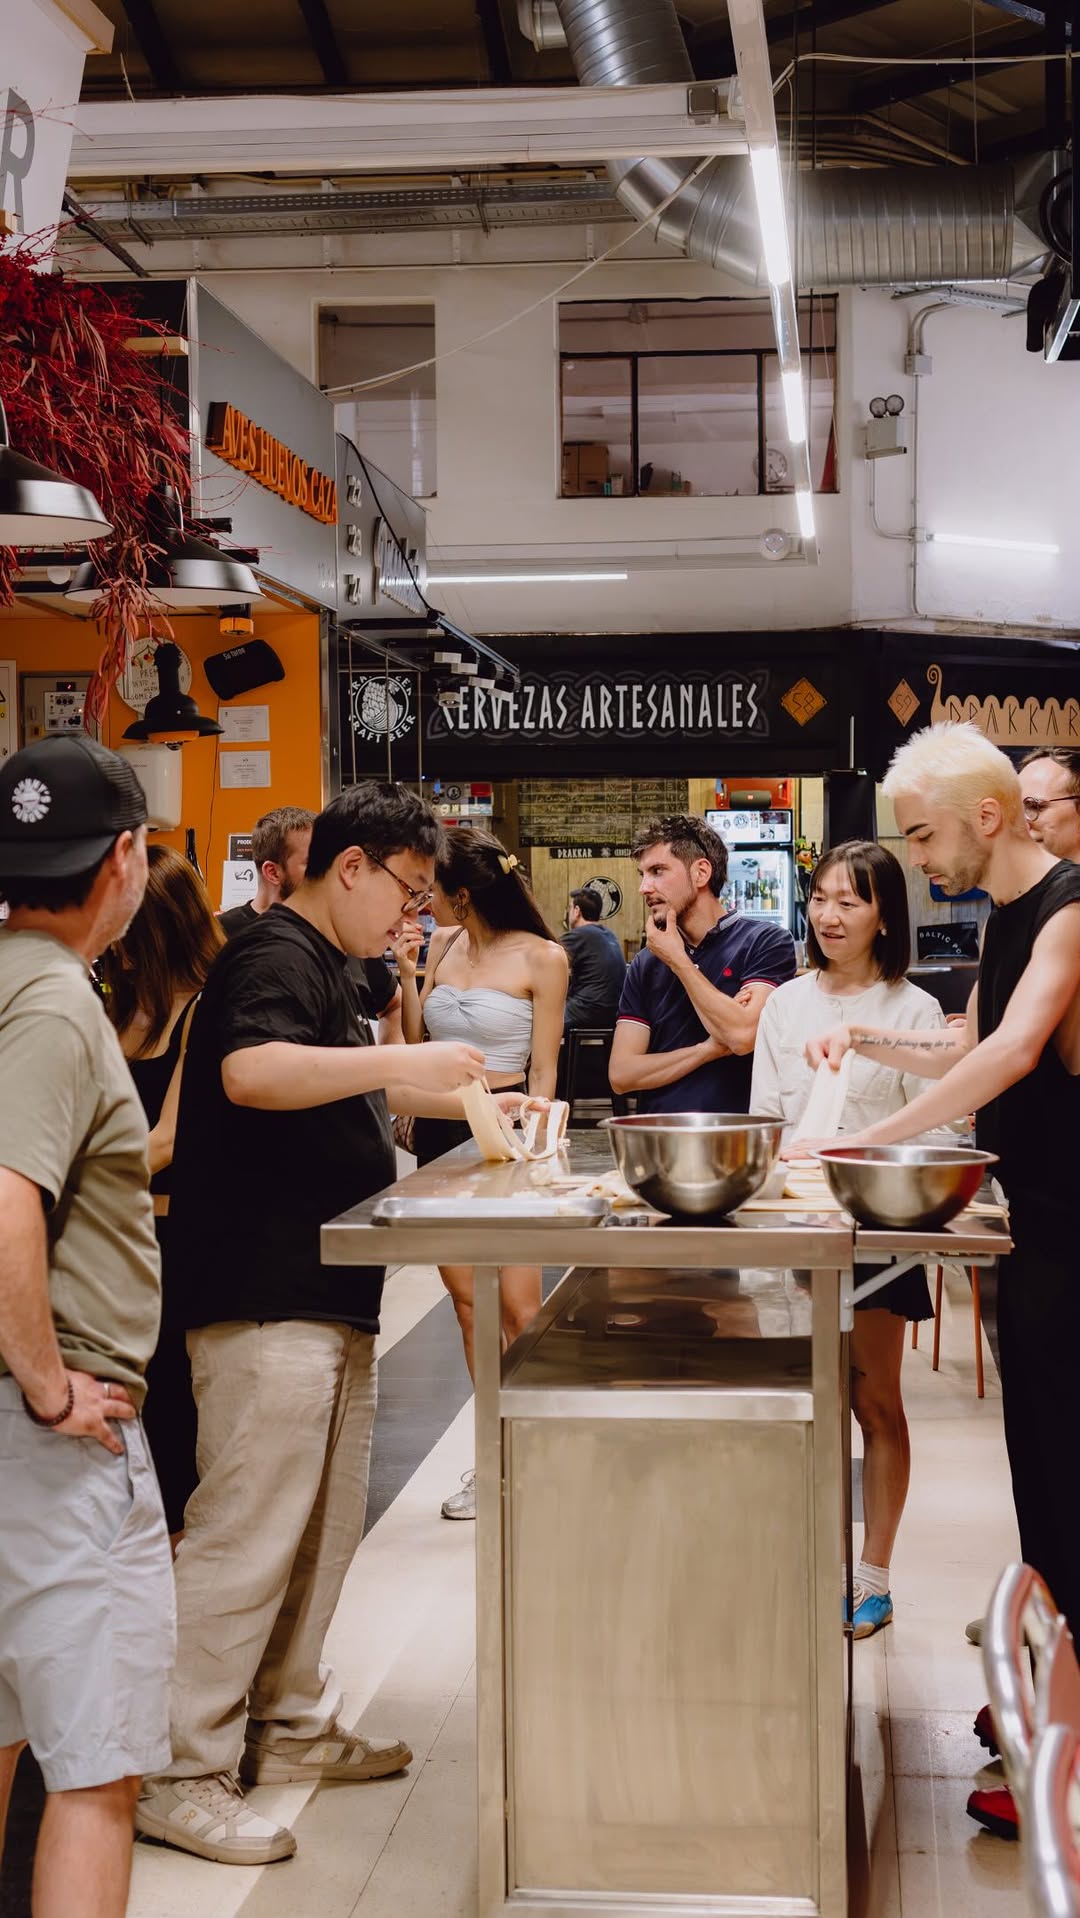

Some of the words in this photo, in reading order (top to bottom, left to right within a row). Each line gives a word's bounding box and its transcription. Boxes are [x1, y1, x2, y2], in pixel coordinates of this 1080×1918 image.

[222, 401, 257, 471] AVES
[260, 427, 308, 506] HUEVOS
[311, 467, 338, 525] CAZA
[580, 683, 758, 729] ARTESANALES
[387, 714, 416, 742] BEER
[557, 848, 593, 858] DRAKKAR
